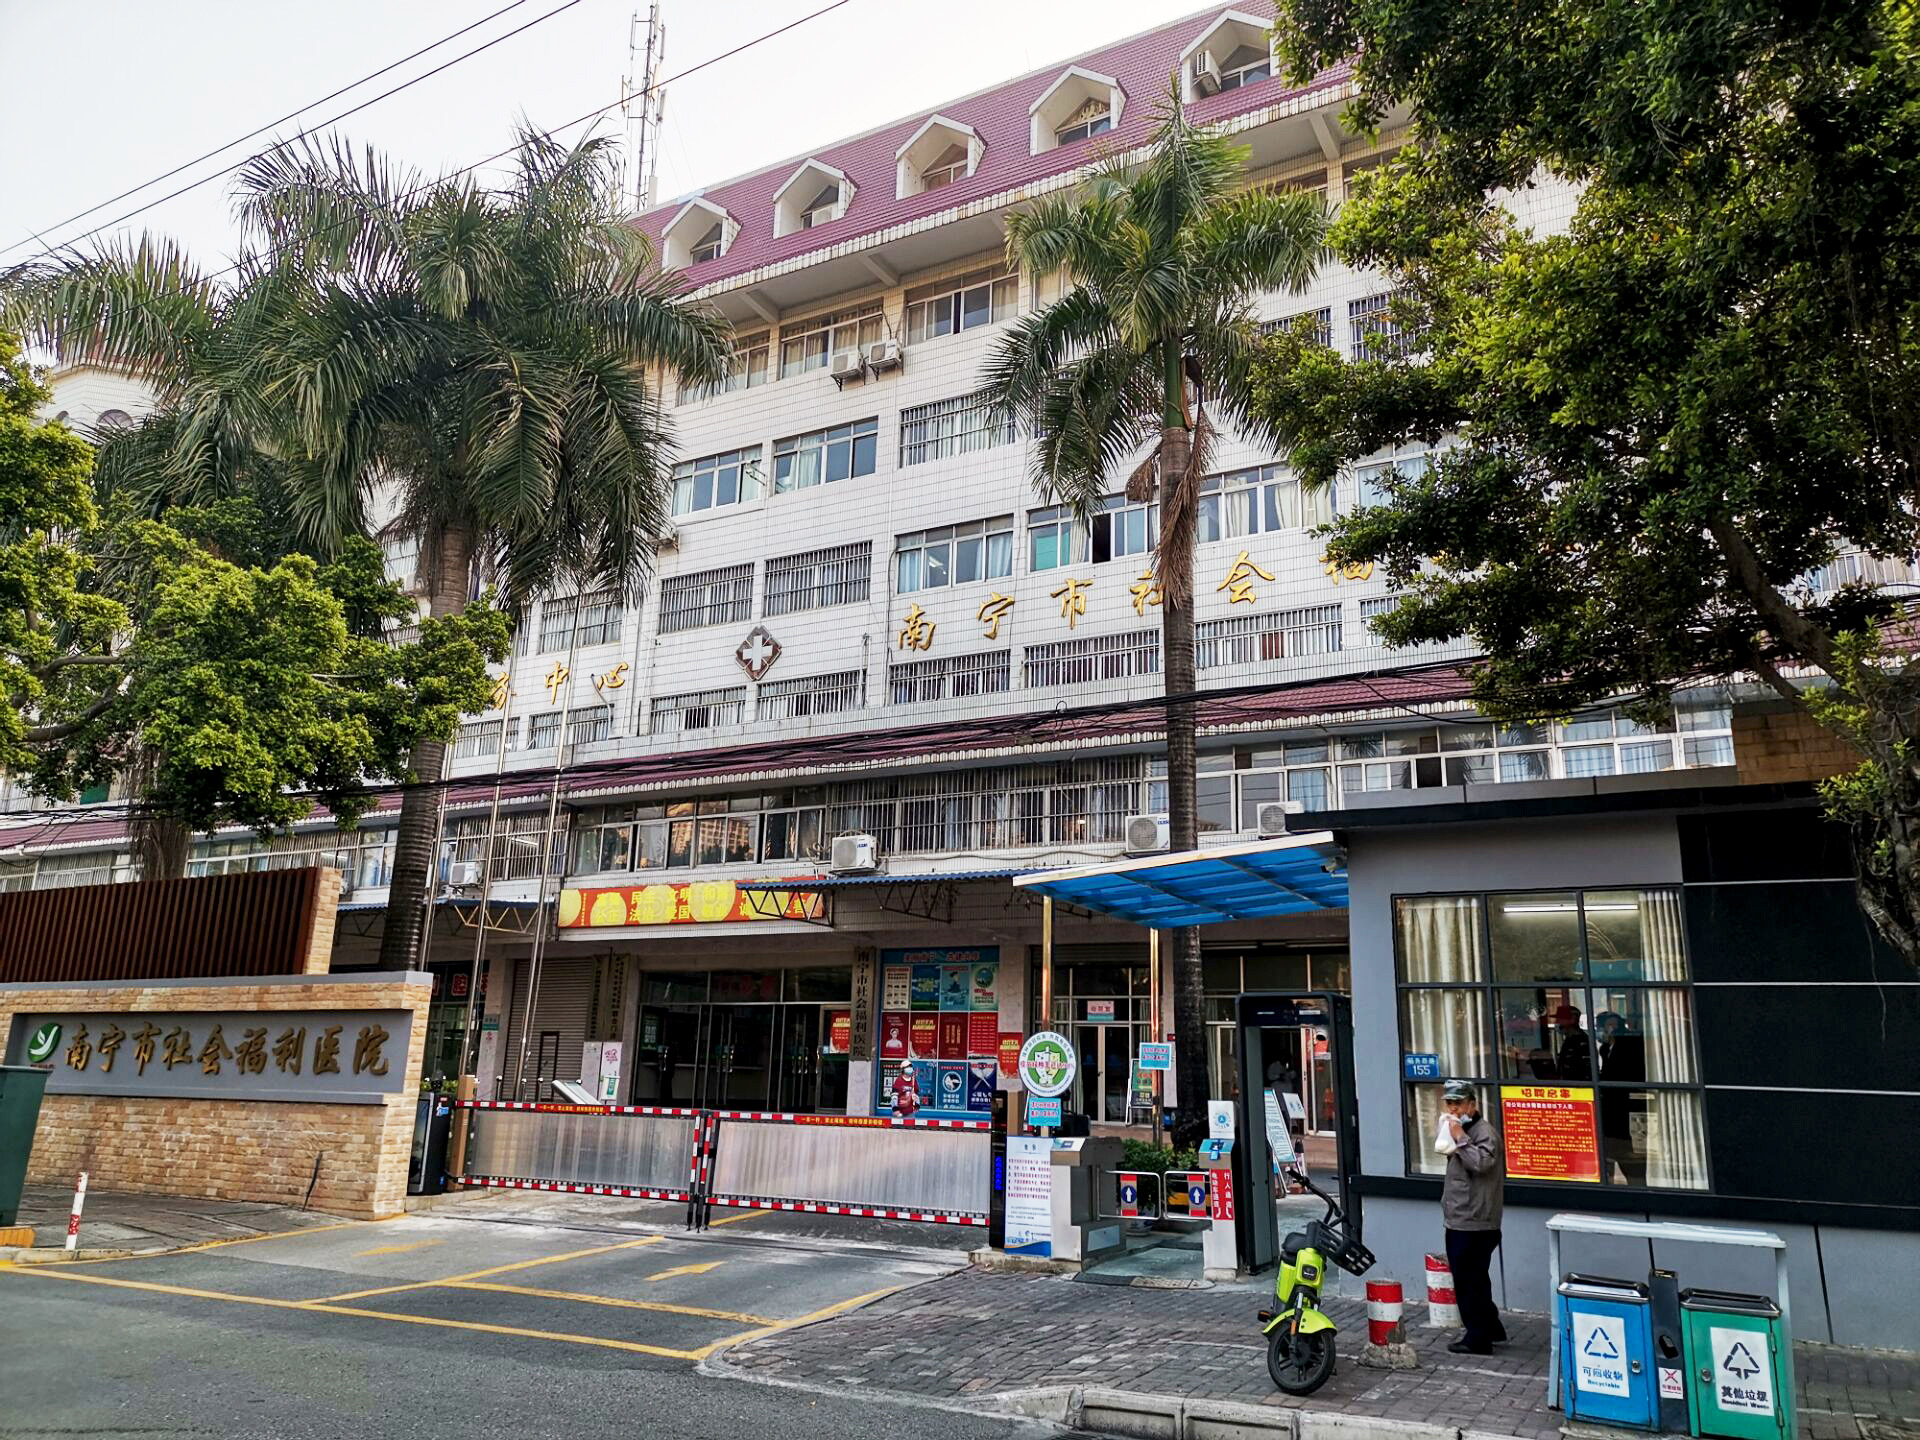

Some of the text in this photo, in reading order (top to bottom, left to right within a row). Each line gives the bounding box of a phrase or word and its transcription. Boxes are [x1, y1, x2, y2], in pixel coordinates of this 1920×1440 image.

[64, 1020, 390, 1076] 南宁市社会福利医院
[1413, 1064, 1431, 1076] 155
[1582, 1366, 1623, 1381] 可回收物
[1721, 1385, 1769, 1402] 其他垃圾
